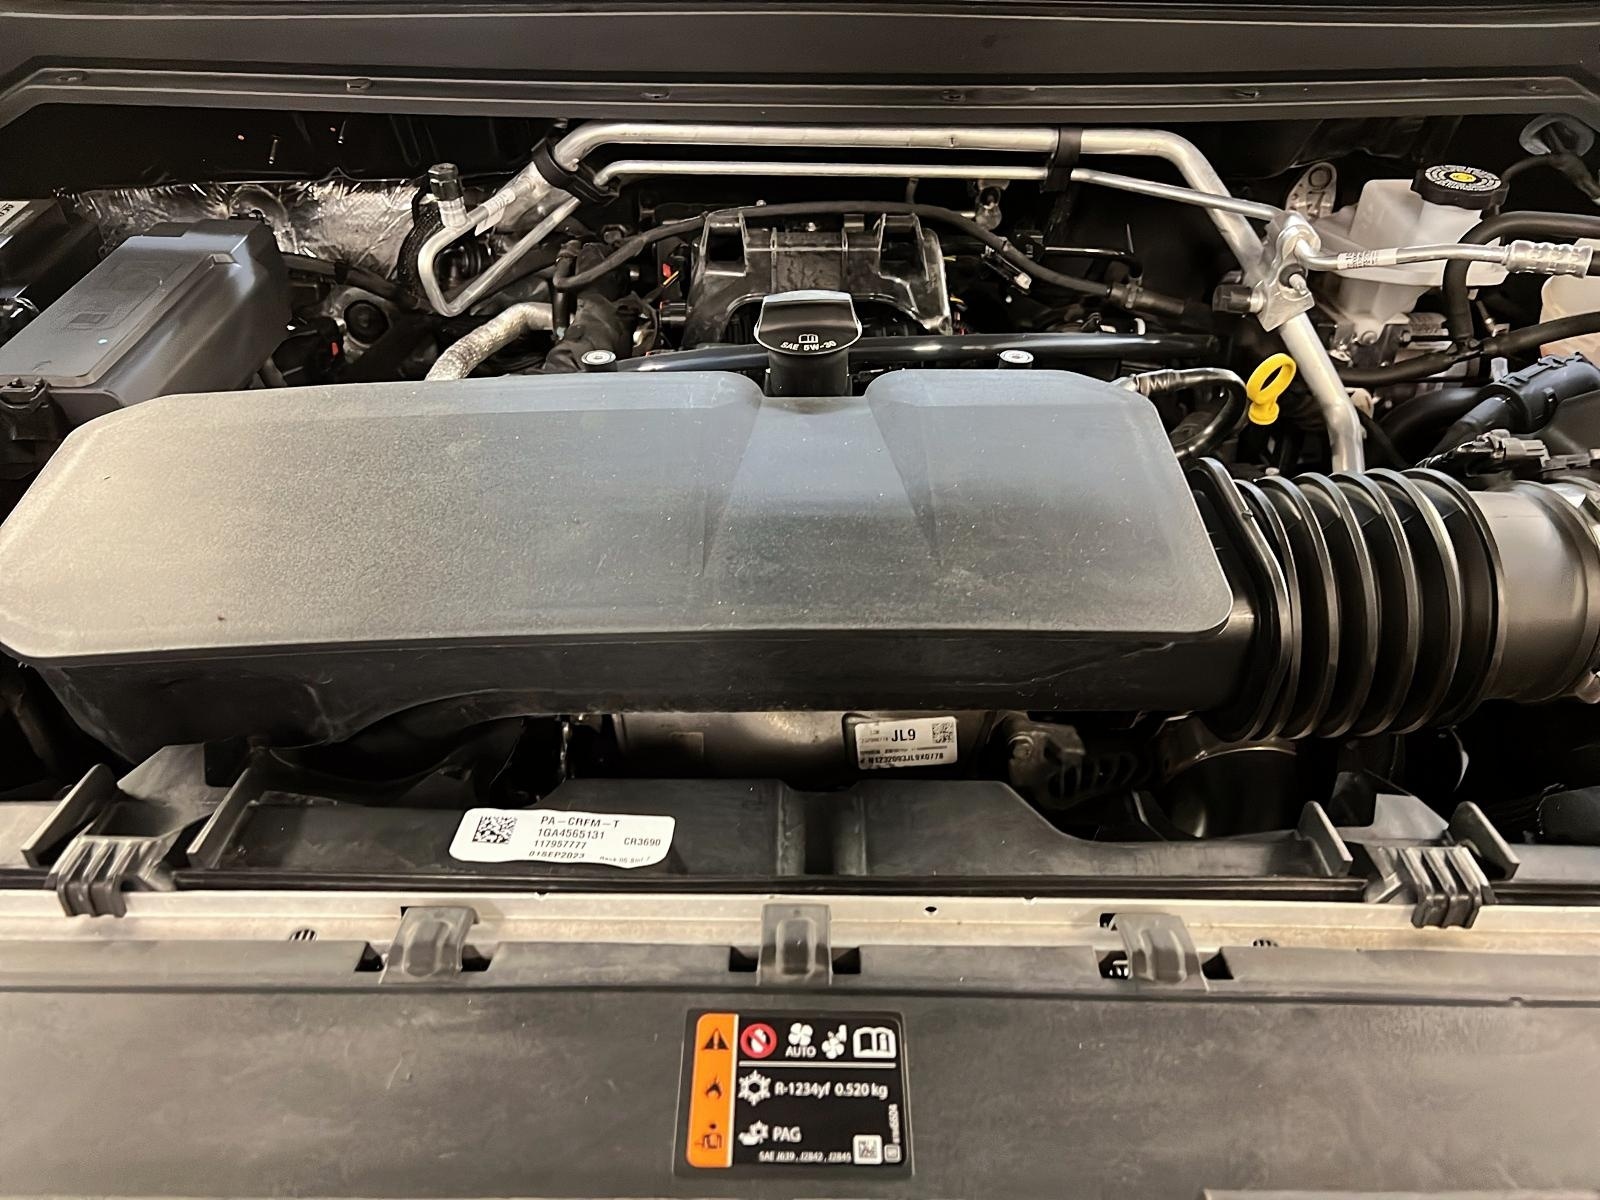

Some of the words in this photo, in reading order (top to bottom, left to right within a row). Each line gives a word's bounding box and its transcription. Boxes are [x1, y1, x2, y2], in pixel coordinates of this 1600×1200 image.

[780, 341, 799, 351] SAE
[803, 340, 837, 351] 5W-30
[891, 728, 916, 742] JL9
[538, 828, 605, 840] 1GA4565131
[533, 839, 587, 850] 117957777
[623, 837, 662, 848] CR3690
[785, 1045, 817, 1058] AUTO
[774, 1081, 831, 1100] R-1234yf
[834, 1082, 869, 1097] 0.520
[871, 1082, 889, 1100] kg
[772, 1126, 801, 1142] PAG
[758, 1151, 775, 1162] SAE
